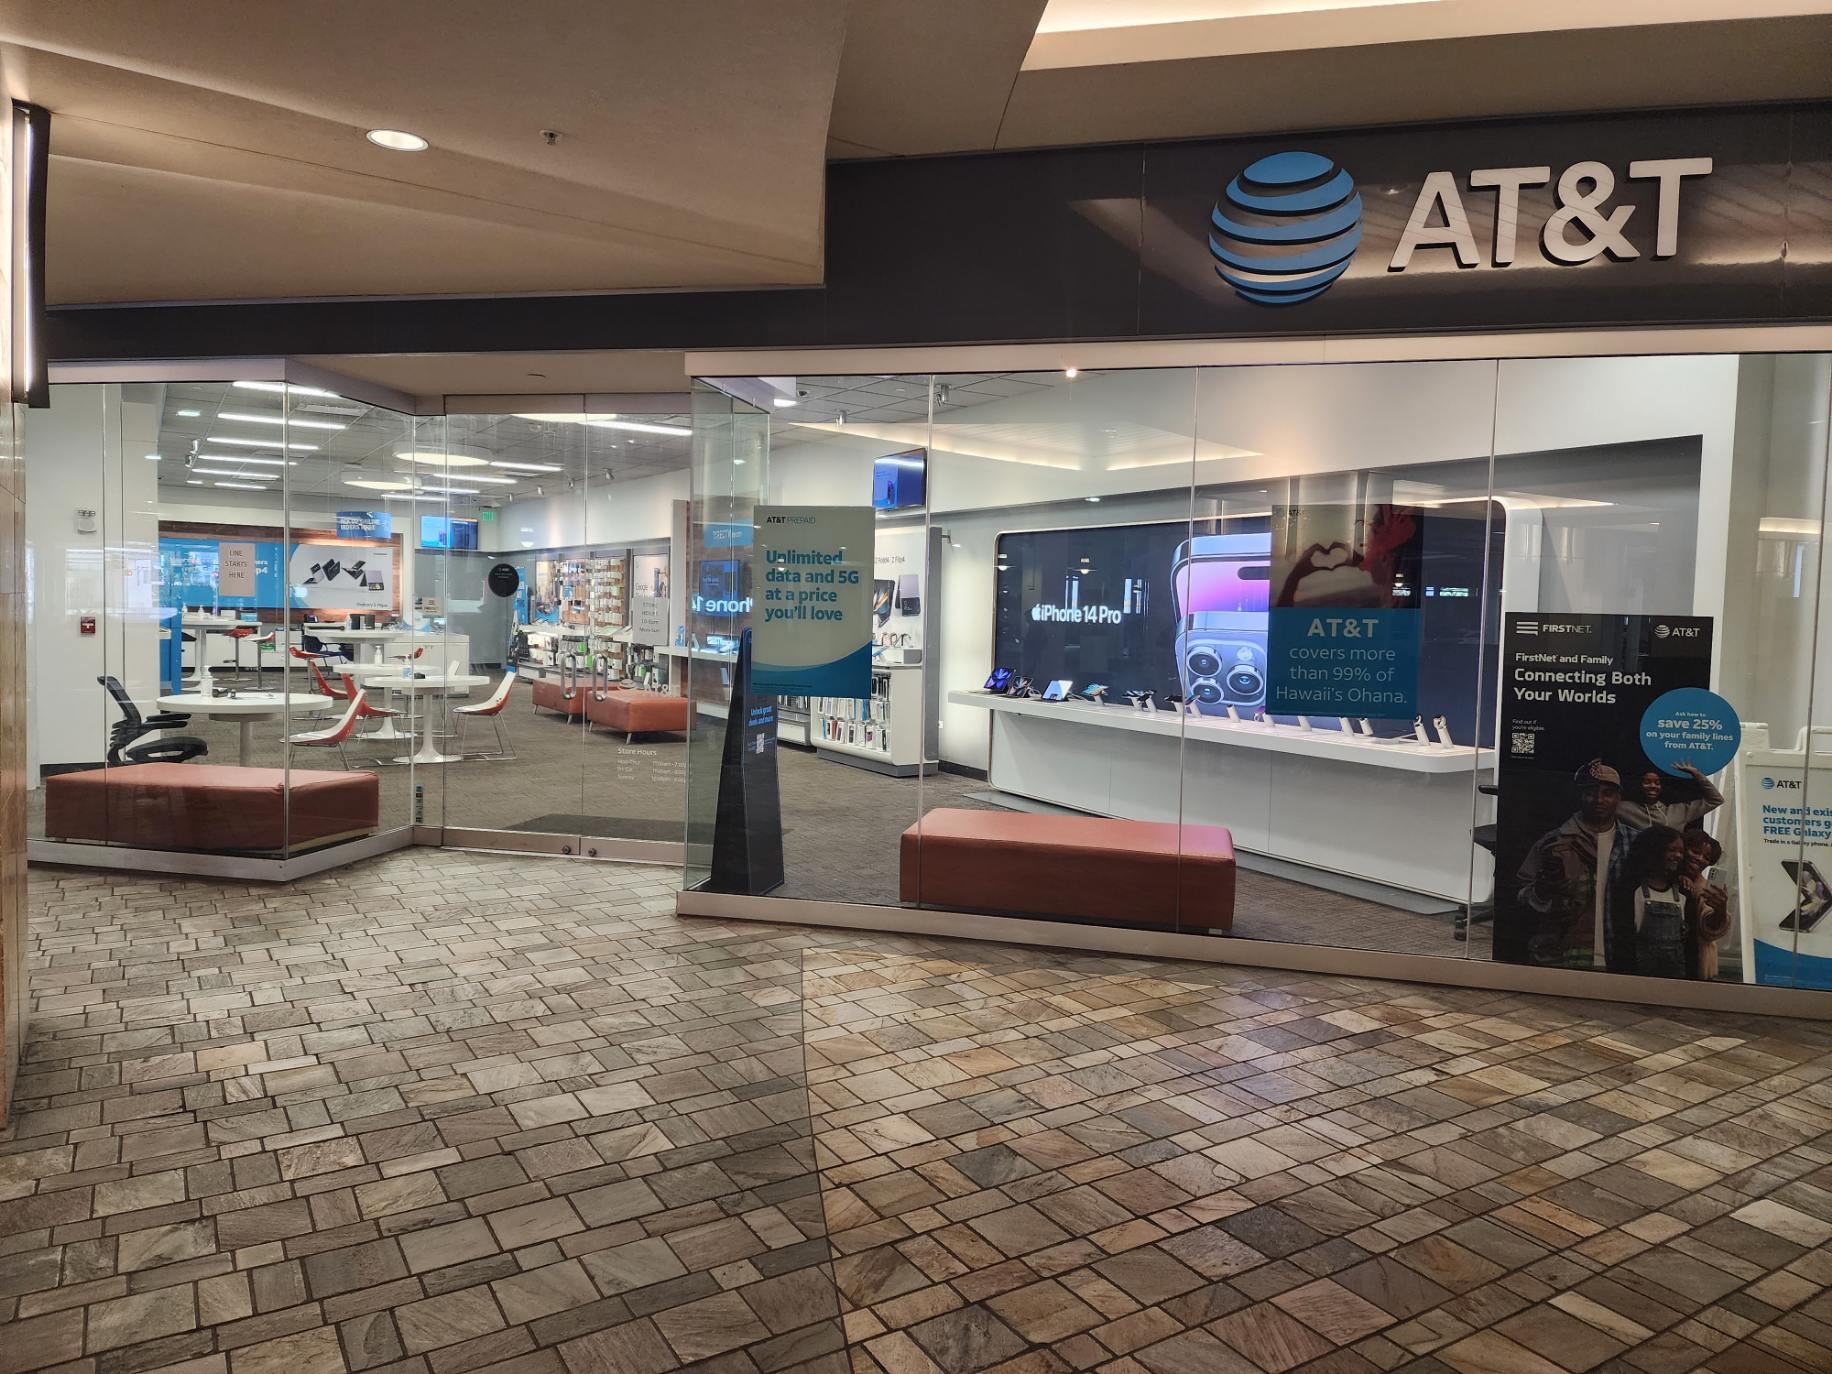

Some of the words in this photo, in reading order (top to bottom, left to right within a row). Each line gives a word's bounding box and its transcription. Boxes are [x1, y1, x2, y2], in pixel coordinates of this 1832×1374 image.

[1388, 157, 1713, 271] AT&T
[766, 516, 786, 524] AT&T
[766, 550, 843, 565] Unlimited
[766, 568, 800, 583] data
[805, 569, 835, 583] and
[838, 570, 859, 584] 5G
[765, 587, 783, 601] at
[786, 590, 795, 601] a
[799, 587, 838, 605] price
[764, 605, 806, 622] you'll
[811, 606, 843, 621] love
[1041, 604, 1082, 622] iPhone
[1082, 605, 1098, 623] 14
[1098, 605, 1122, 624] Pro
[1307, 618, 1379, 638] AT&T
[1672, 627, 1700, 638] AT&T
[1289, 647, 1345, 660] covers
[1350, 649, 1396, 661] more
[1559, 654, 1578, 663] and
[1580, 655, 1614, 666] Family
[1289, 666, 1328, 681] than
[1333, 666, 1371, 682] 99%
[1376, 667, 1395, 682] of
[1514, 668, 1606, 687] Connecting
[1611, 671, 1652, 686] Both
[1276, 685, 1343, 702] Hawaii's
[1347, 687, 1408, 704] Ohana.
[1514, 687, 1553, 702] Your
[1558, 688, 1617, 704] Worlds
[1657, 720, 1690, 729] save
[1692, 718, 1723, 730] 25%
[1659, 732, 1680, 740] your
[1682, 731, 1711, 742] family
[1712, 732, 1734, 741] lines
[617, 747, 636, 755] Store
[637, 748, 657, 756] Hours
[1664, 741, 1687, 749] from
[1776, 780, 1802, 790] AT&T
[1763, 804, 1787, 814] New
[1790, 806, 1811, 816] and
[1763, 825, 1791, 836] FREE
